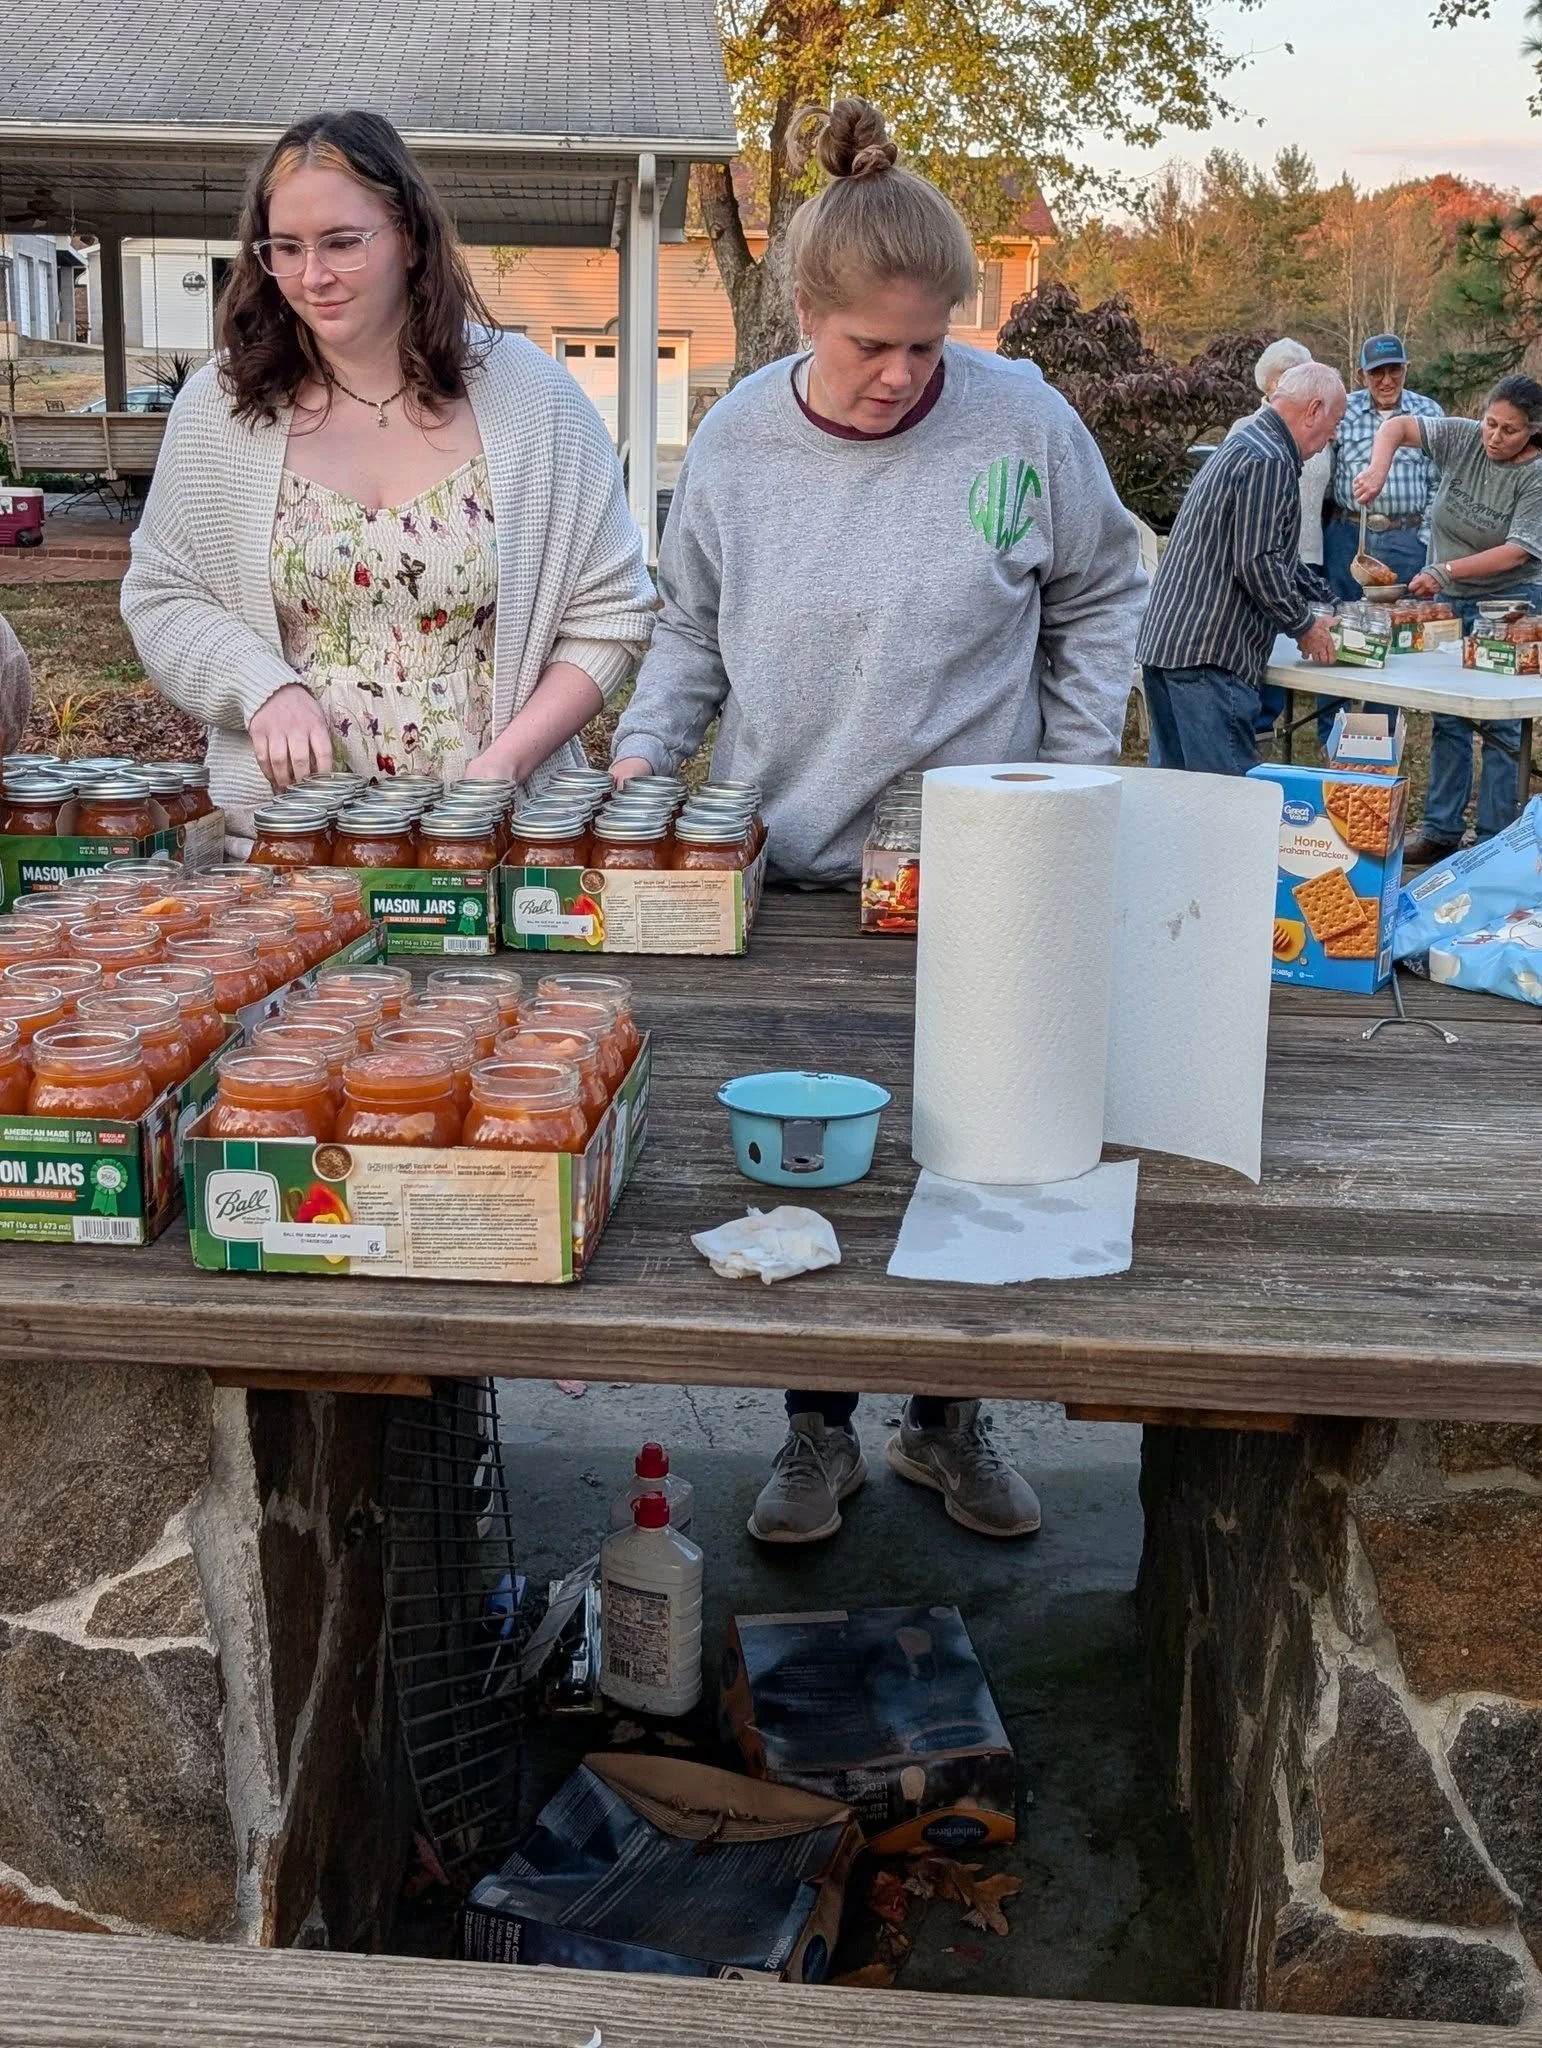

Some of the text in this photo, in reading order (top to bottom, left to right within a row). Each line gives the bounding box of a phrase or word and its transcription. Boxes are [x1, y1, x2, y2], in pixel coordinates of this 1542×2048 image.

[1284, 805, 1309, 816] Great
[1294, 835, 1332, 851] Honey
[1312, 849, 1348, 860] Crackers
[23, 866, 68, 882] MASON
[374, 898, 456, 915] MASON JARS
[519, 898, 553, 915] Ball
[3, 1128, 69, 1138] AMERICAN MADE
[76, 1130, 92, 1138] BPA
[33, 1162, 85, 1186] JARS
[8, 1190, 35, 1198] SEALING
[36, 1191, 58, 1199] MASON
[60, 1192, 73, 1200] JAR
[215, 1189, 271, 1221] Ball
[16, 1222, 27, 1230] (16
[43, 1222, 57, 1230] 473
